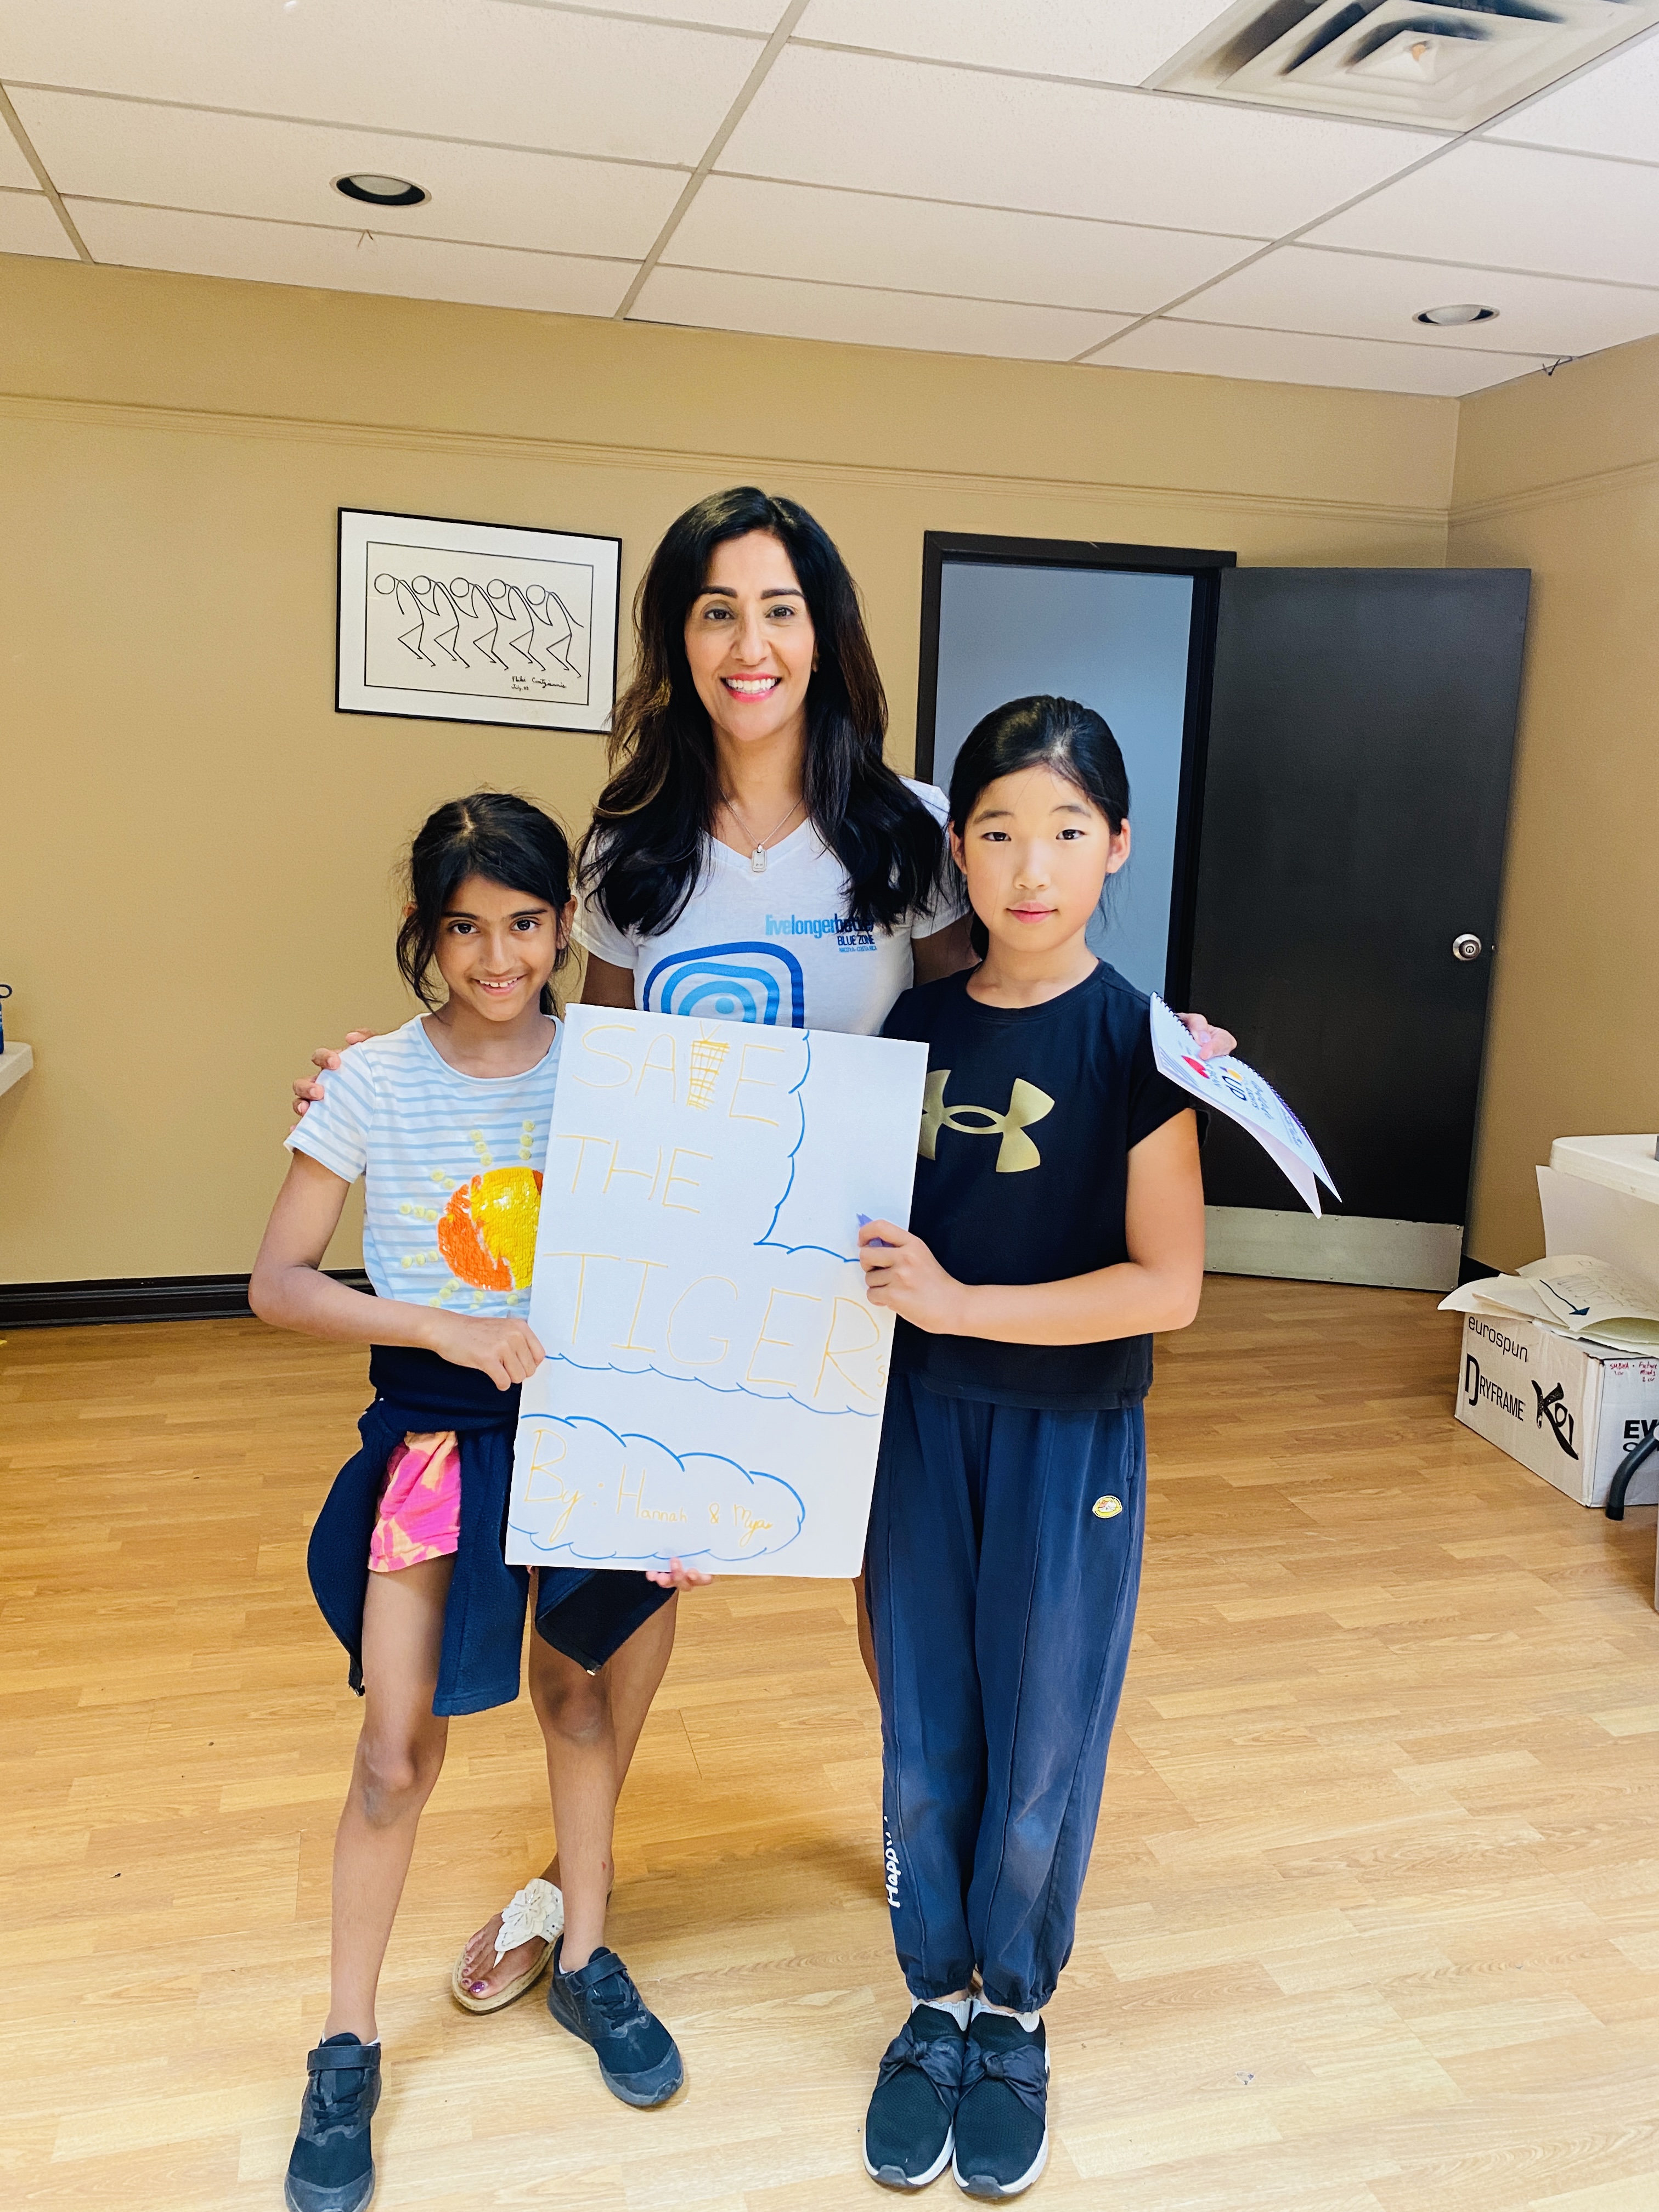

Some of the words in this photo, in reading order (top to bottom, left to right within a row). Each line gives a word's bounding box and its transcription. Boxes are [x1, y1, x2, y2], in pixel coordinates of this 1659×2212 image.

[837, 935, 856, 945] BLUE
[857, 934, 875, 945] ZONE
[572, 1020, 785, 1127] SAVE
[557, 1133, 713, 1214] THE
[1469, 1316, 1528, 1363] eurospun
[1465, 1353, 1524, 1421] DRYFRAME
[1624, 1419, 1659, 1438] EV
[617, 1465, 687, 1523] Hannah
[709, 1503, 720, 1523] &
